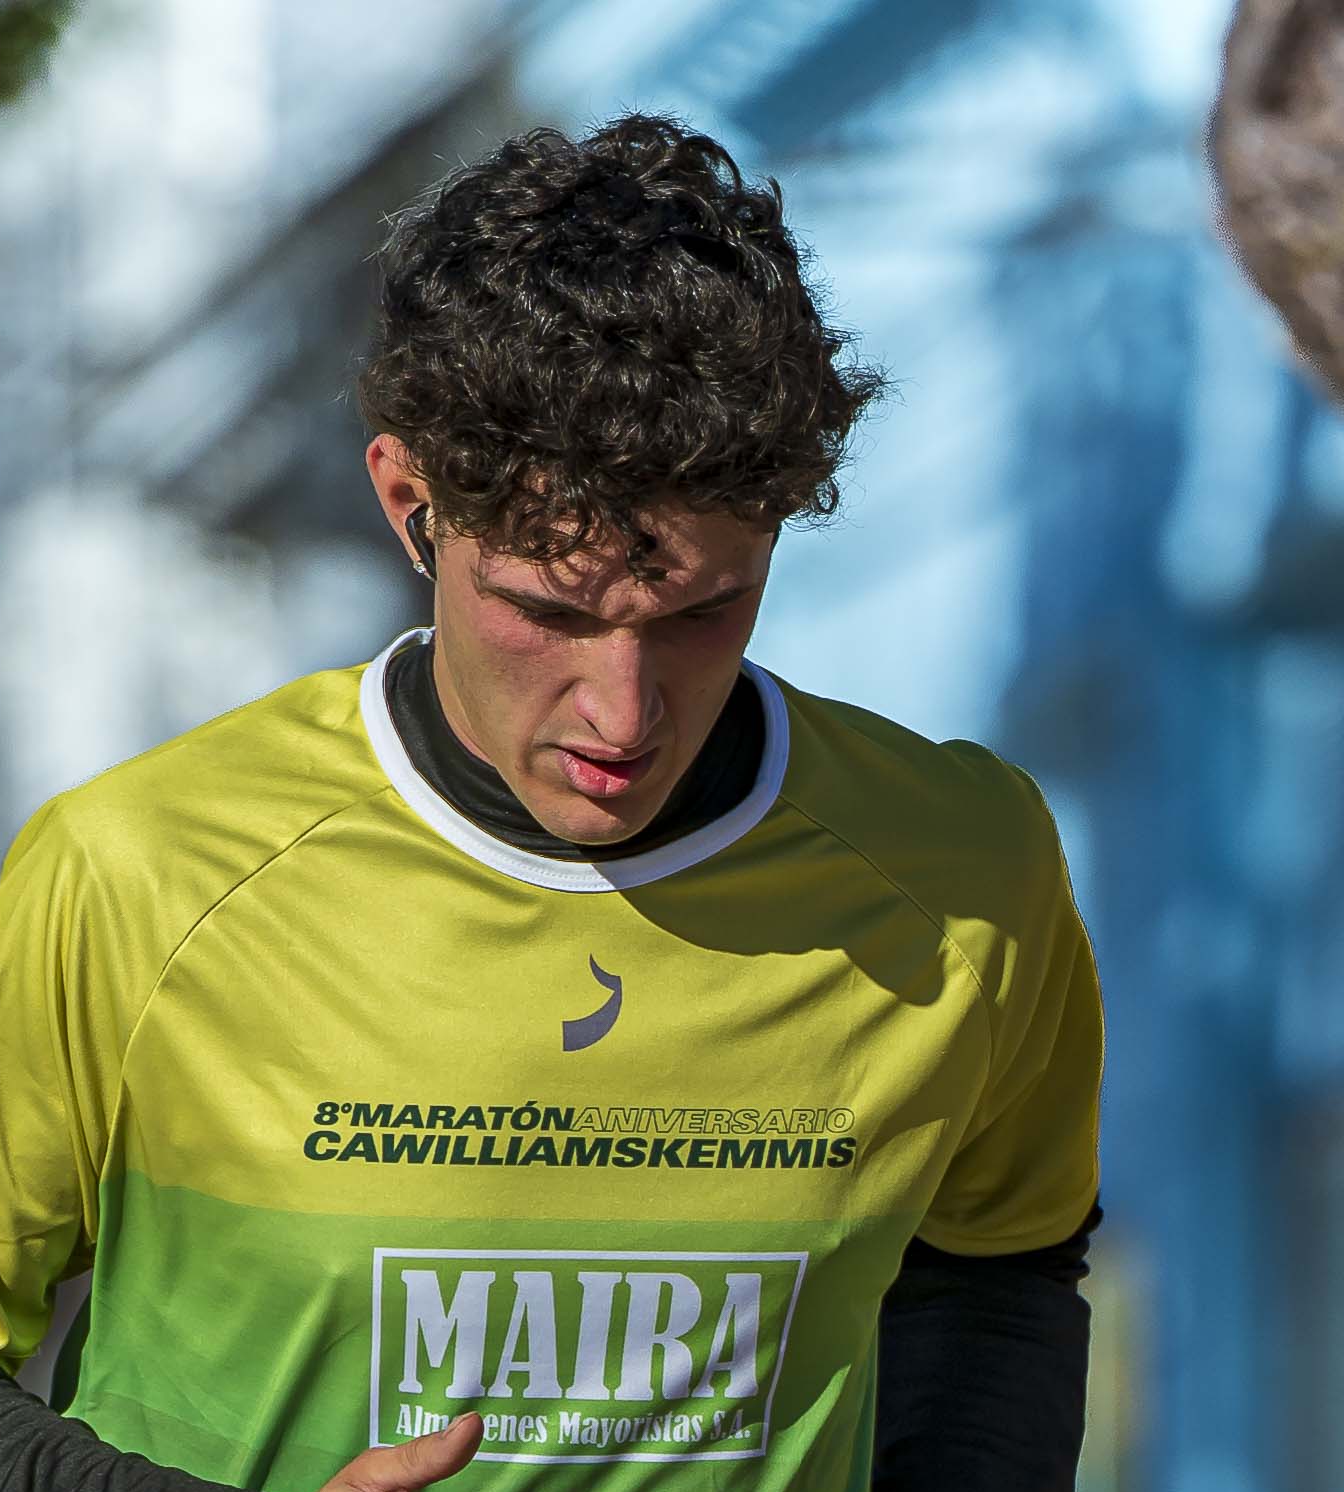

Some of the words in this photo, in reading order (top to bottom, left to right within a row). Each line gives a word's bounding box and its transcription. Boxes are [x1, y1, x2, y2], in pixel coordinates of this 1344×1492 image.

[303, 1130, 857, 1168] CAWILLIAMSKEMMIS
[397, 1269, 763, 1400] MAIRA
[395, 1403, 548, 1446] Almenes
[558, 1409, 704, 1449] Mayoristas
[710, 1408, 752, 1441] S.A.
